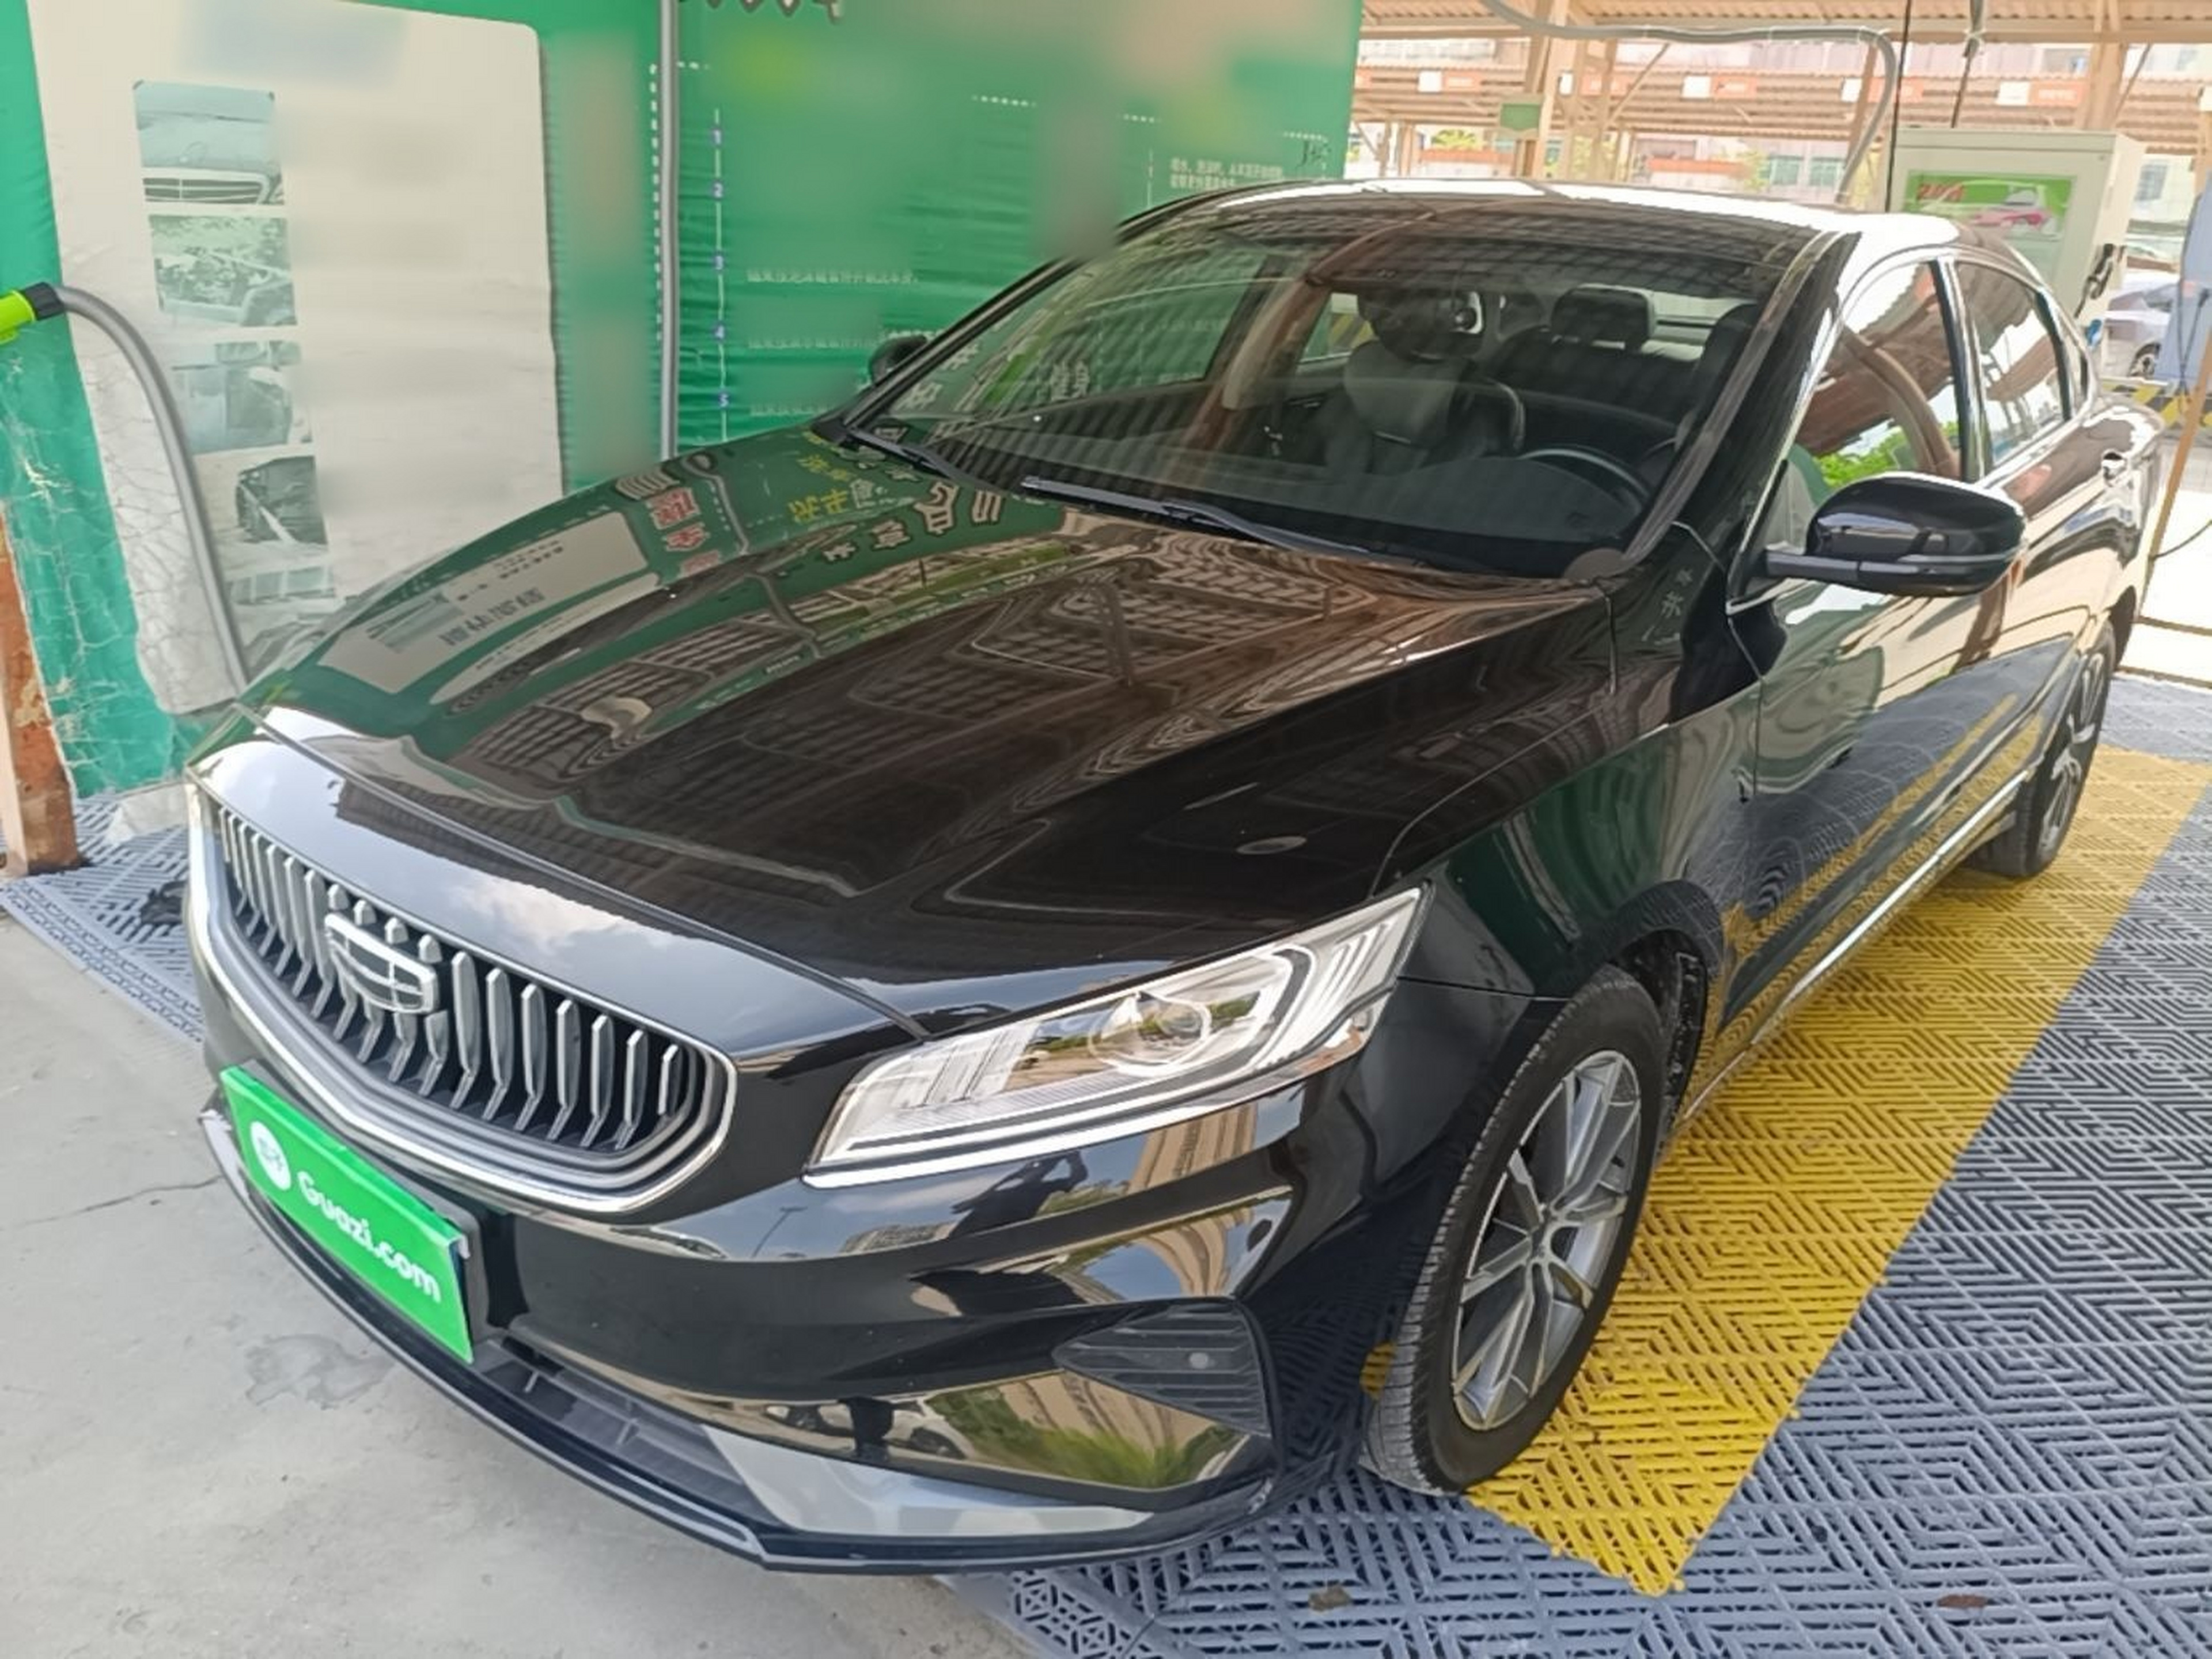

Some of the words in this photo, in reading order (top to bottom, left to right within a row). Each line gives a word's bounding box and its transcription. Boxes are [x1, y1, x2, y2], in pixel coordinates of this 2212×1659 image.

[714, 183, 723, 198] 2
[716, 325, 724, 339] 4
[719, 393, 728, 407] 5
[297, 1171, 441, 1303] Guazi.com
